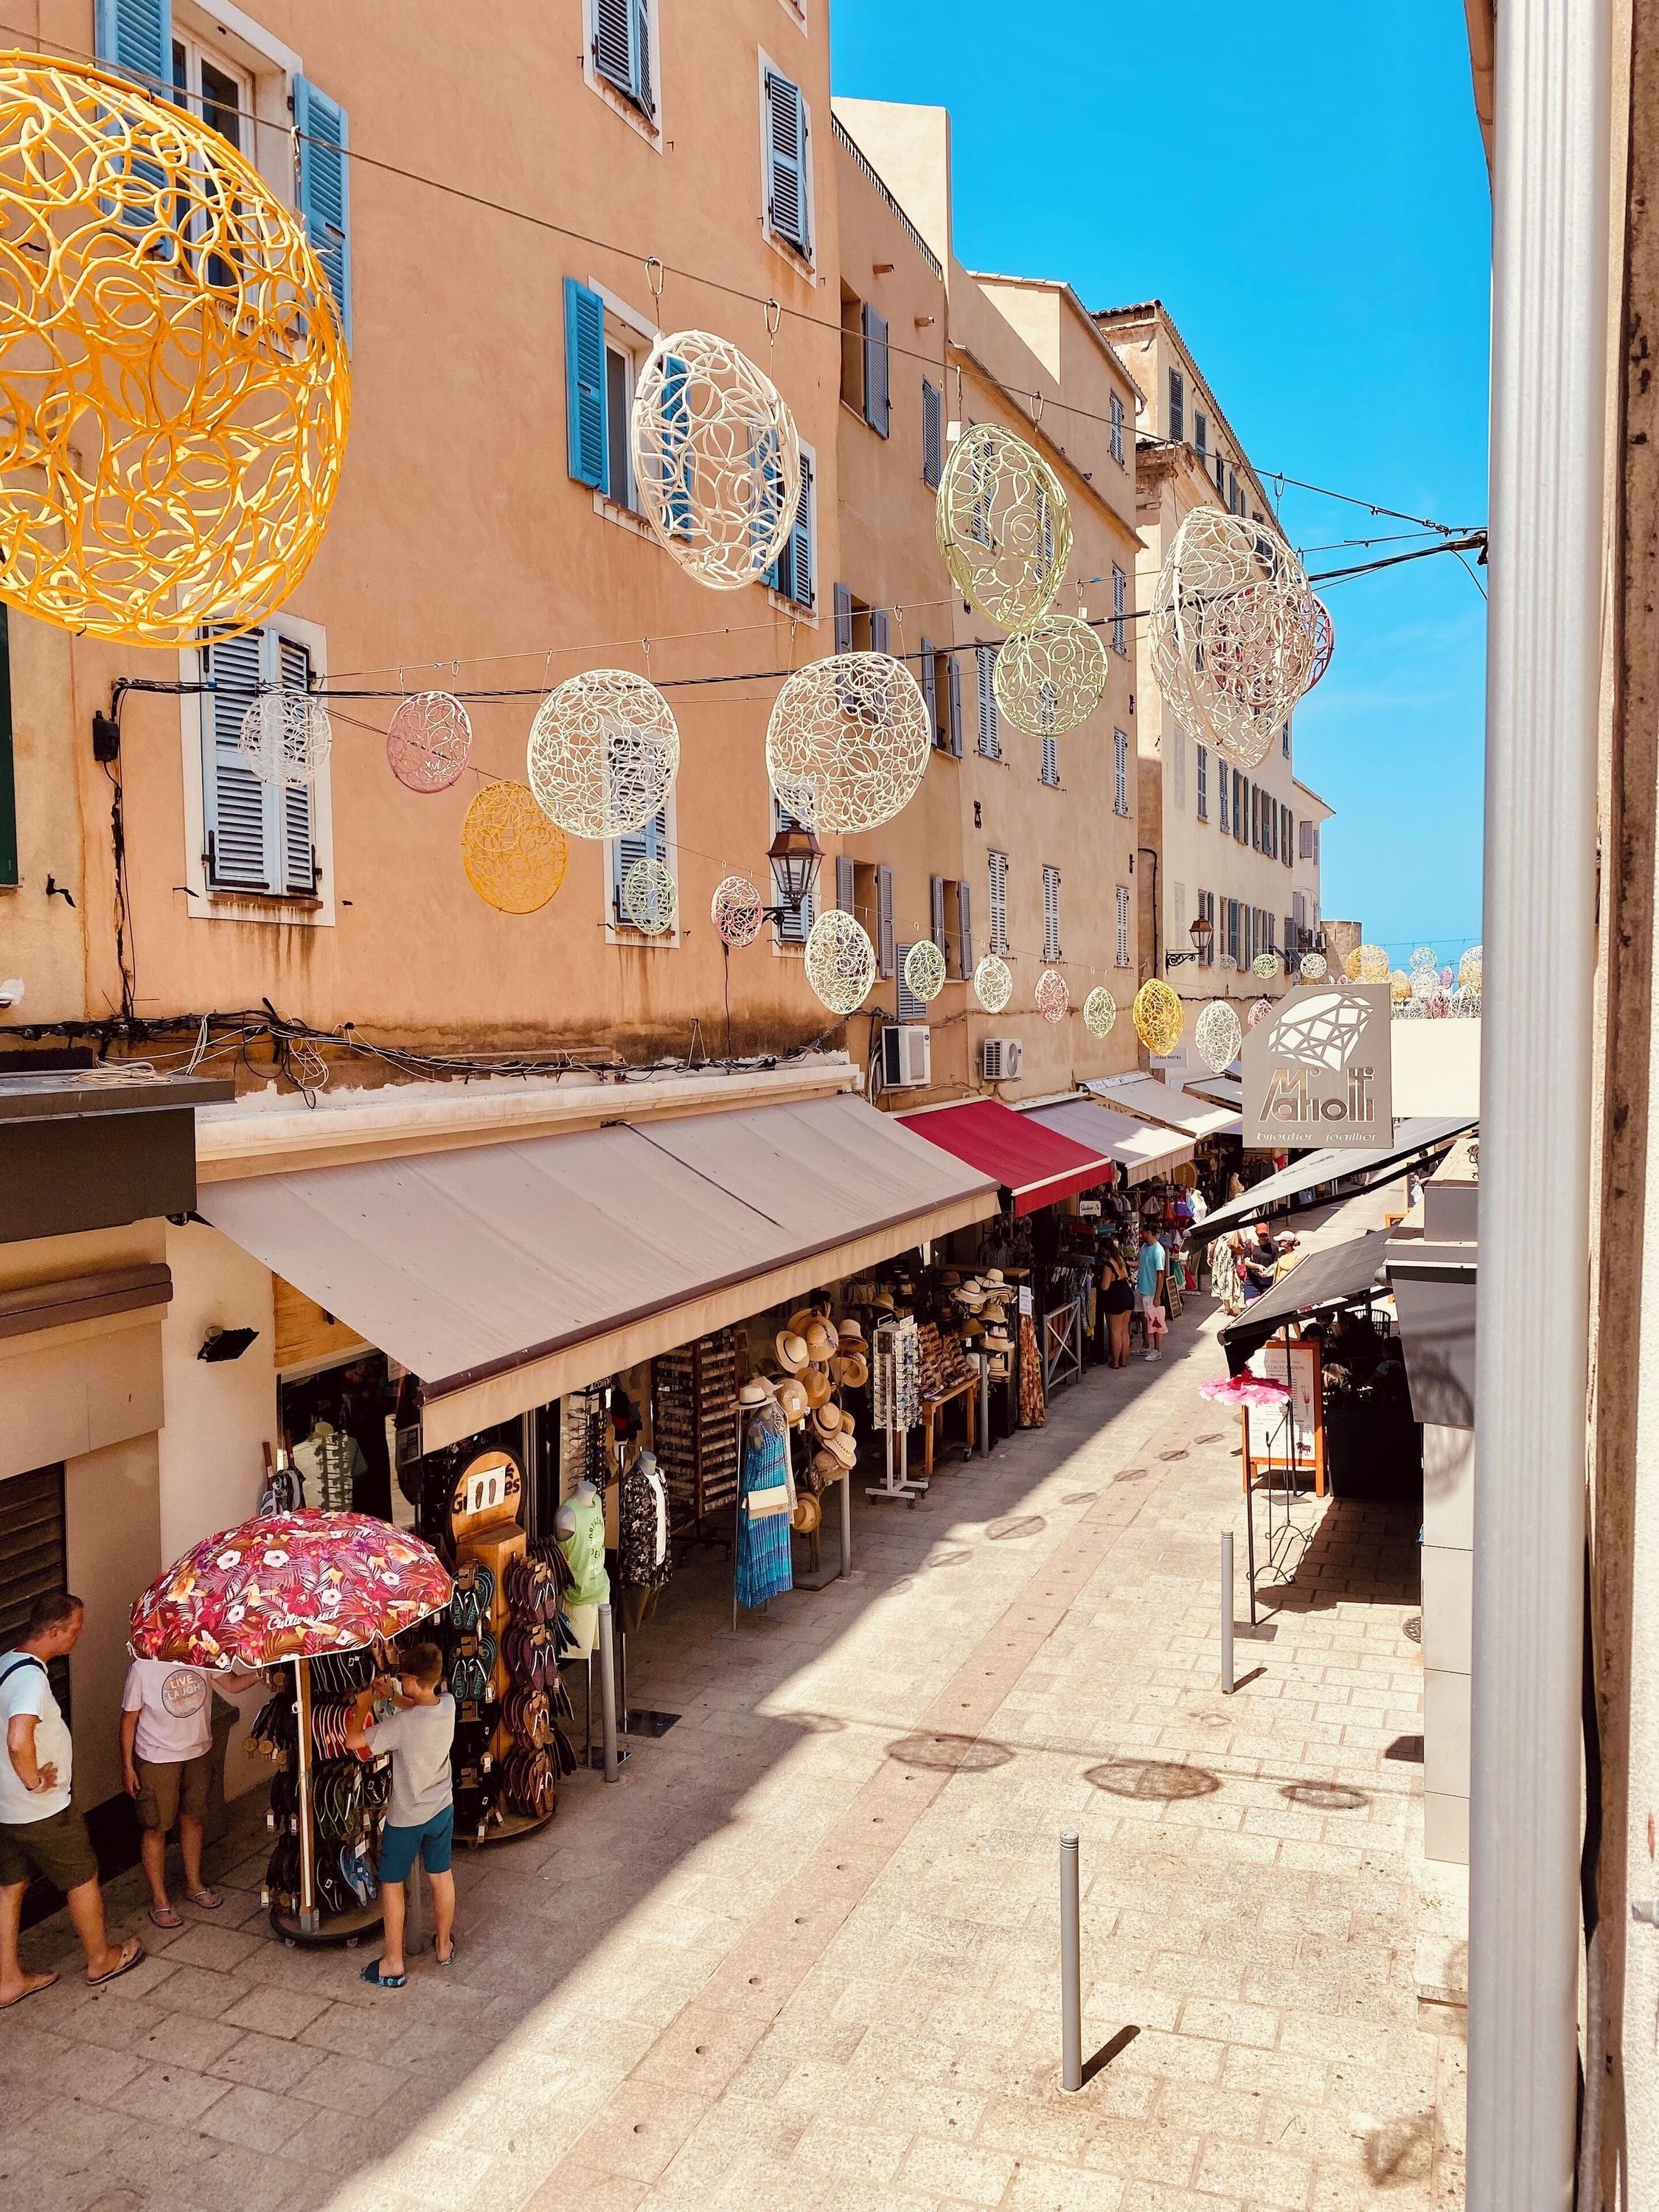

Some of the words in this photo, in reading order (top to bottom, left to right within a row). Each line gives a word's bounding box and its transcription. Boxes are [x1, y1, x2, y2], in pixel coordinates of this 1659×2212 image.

[1256, 1131, 1313, 1142] bijoutier
[1324, 1131, 1377, 1142] joaillier
[316, 1604, 340, 1622] sud
[170, 1674, 193, 1689] LIVE
[167, 1683, 201, 1700] LAUGH
